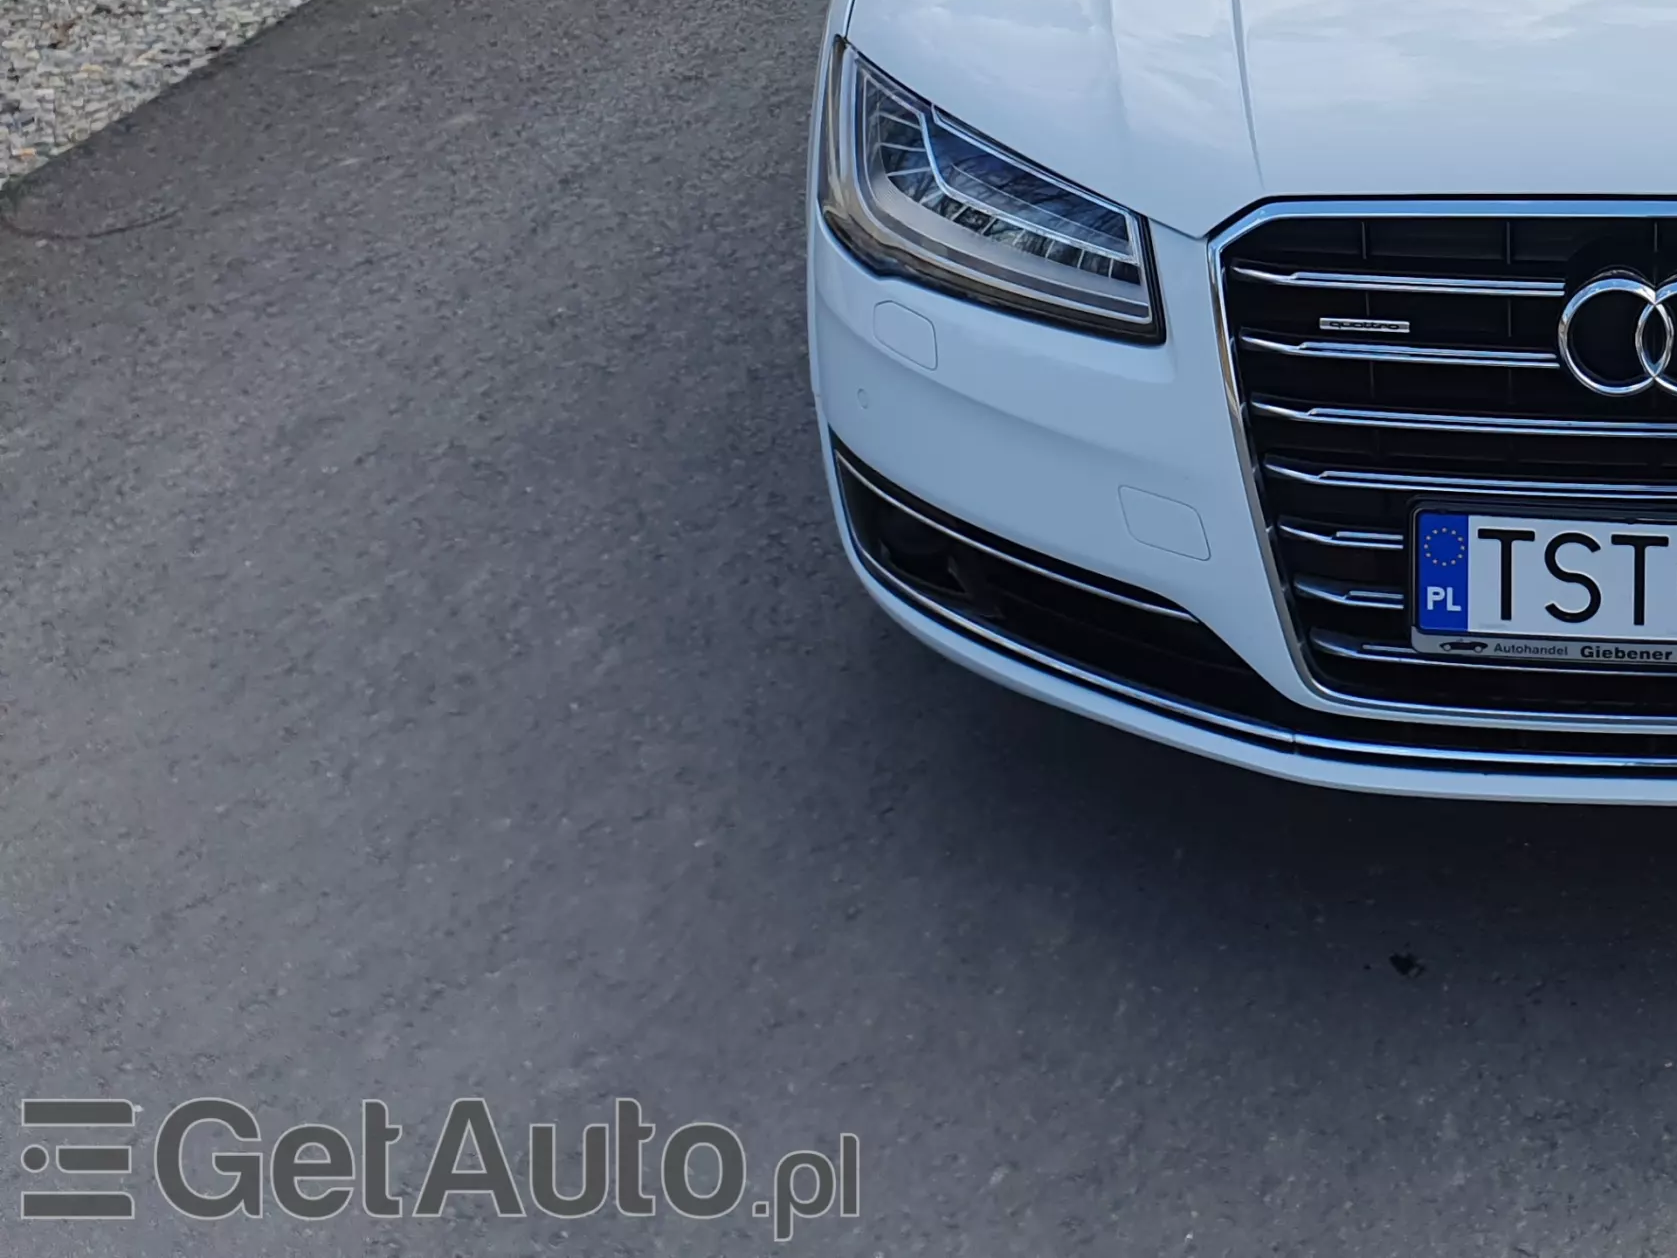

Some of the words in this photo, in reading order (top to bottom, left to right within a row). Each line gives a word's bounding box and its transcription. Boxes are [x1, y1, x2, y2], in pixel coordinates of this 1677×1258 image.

[1328, 320, 1400, 331] quattro
[1477, 527, 1669, 626] TST
[1426, 586, 1461, 611] PL
[1494, 642, 1569, 657] Autohandel
[1580, 645, 1673, 661] Giebener
